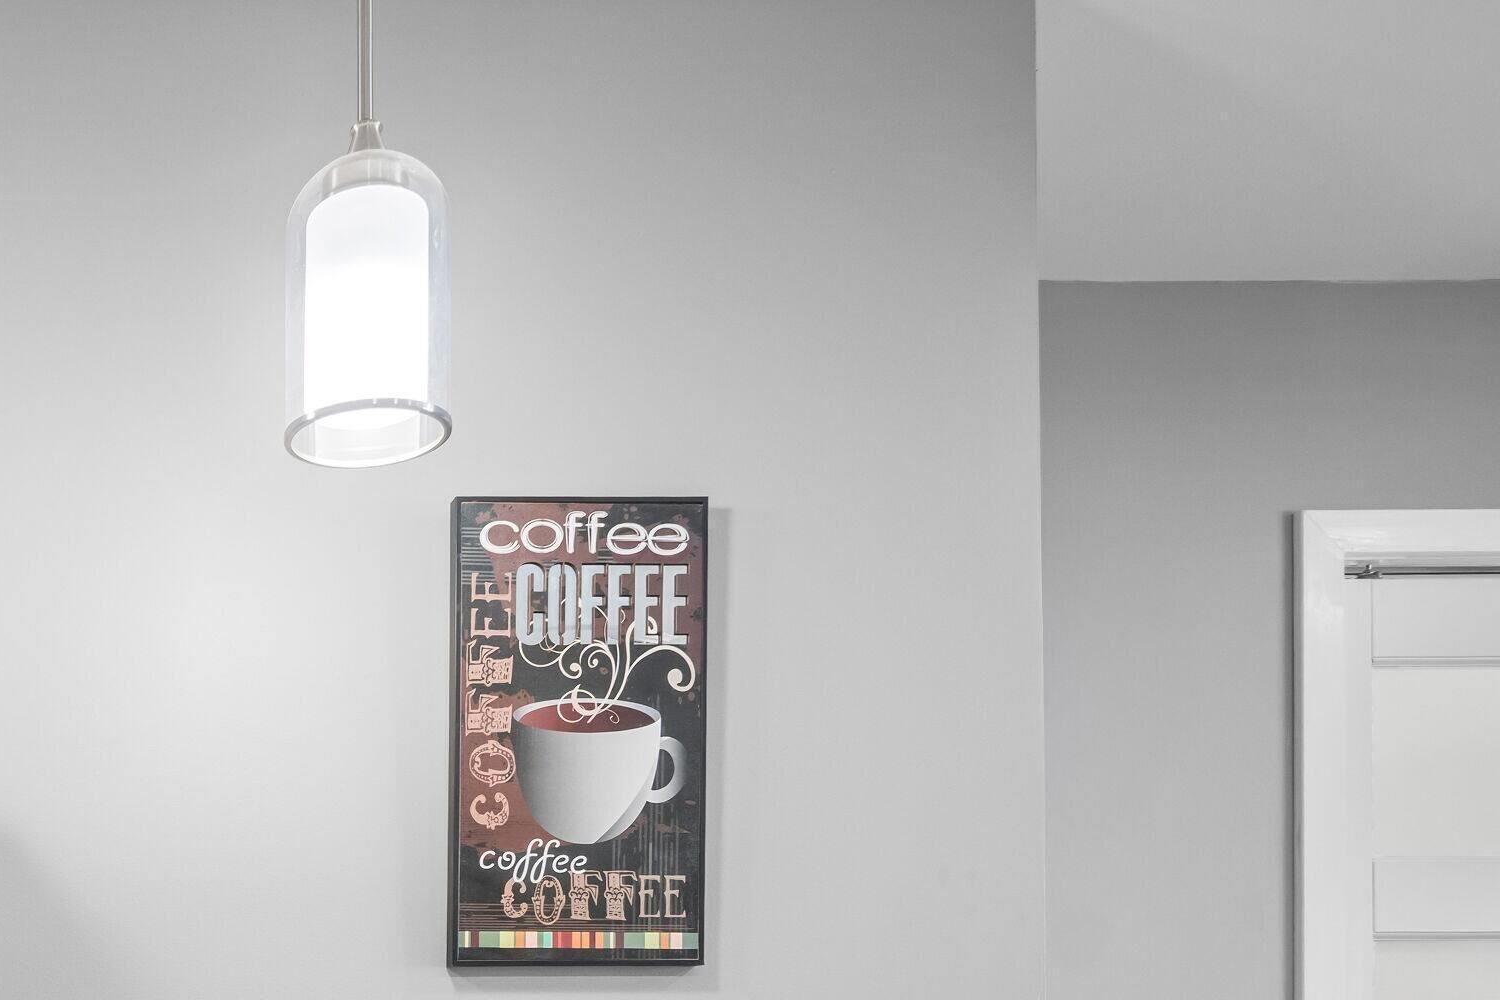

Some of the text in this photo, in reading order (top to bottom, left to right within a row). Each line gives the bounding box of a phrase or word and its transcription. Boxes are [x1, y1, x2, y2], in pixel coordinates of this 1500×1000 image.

[479, 510, 690, 555] coffee
[515, 561, 689, 646] COFFEE
[465, 571, 516, 831] COFFEE
[479, 838, 588, 883] coffee
[500, 870, 687, 926] COFFEE
